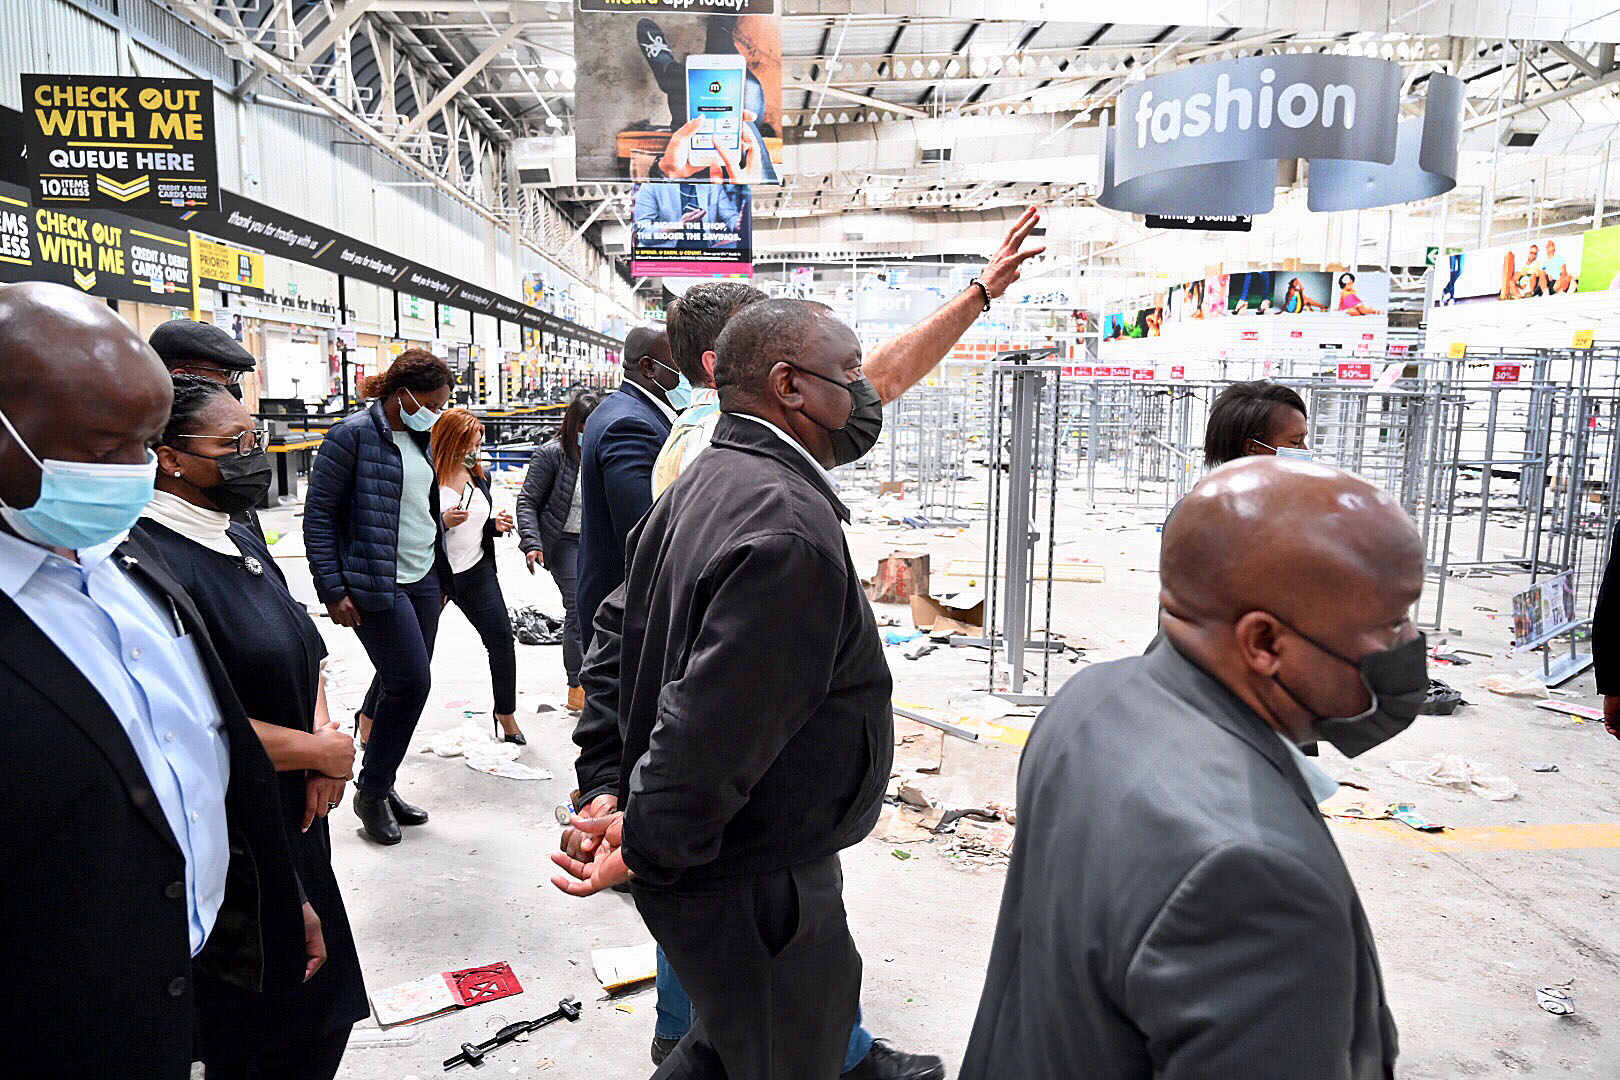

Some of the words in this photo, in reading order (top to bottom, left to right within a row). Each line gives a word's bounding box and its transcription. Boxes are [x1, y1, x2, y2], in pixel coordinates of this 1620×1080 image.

[34, 85, 130, 109] CHECK
[138, 87, 200, 111] OUT
[1135, 68, 1356, 149] fashion
[35, 109, 136, 138] WITH
[149, 112, 204, 141] ME
[49, 149, 129, 170] QUEUE
[136, 152, 195, 172] HERE
[39, 179, 61, 196] 10
[61, 179, 90, 189] ITEMS
[61, 188, 69, 196] &
[69, 187, 90, 197] LESS
[186, 191, 208, 199] ONLY
[0, 211, 29, 238] MS
[36, 208, 89, 241] CHECK
[92, 222, 122, 248] OUT
[227, 211, 252, 229] thank
[248, 221, 265, 233] you
[263, 222, 276, 236] for
[273, 227, 298, 247] trading
[308, 241, 319, 250] us
[637, 232, 652, 240] THE
[685, 232, 701, 240] THE
[702, 233, 741, 241] SAVINGS.
[685, 222, 701, 230] THE
[702, 222, 727, 231] SHOP,
[36, 232, 93, 269] WITH
[98, 246, 126, 275] ME
[130, 245, 159, 262] CREDIT
[160, 251, 168, 265] &
[168, 253, 188, 270] DEBIT
[199, 254, 230, 271] PRIORITY
[131, 260, 164, 280] CARDS
[164, 266, 189, 284] ONLY
[280, 295, 296, 313] you
